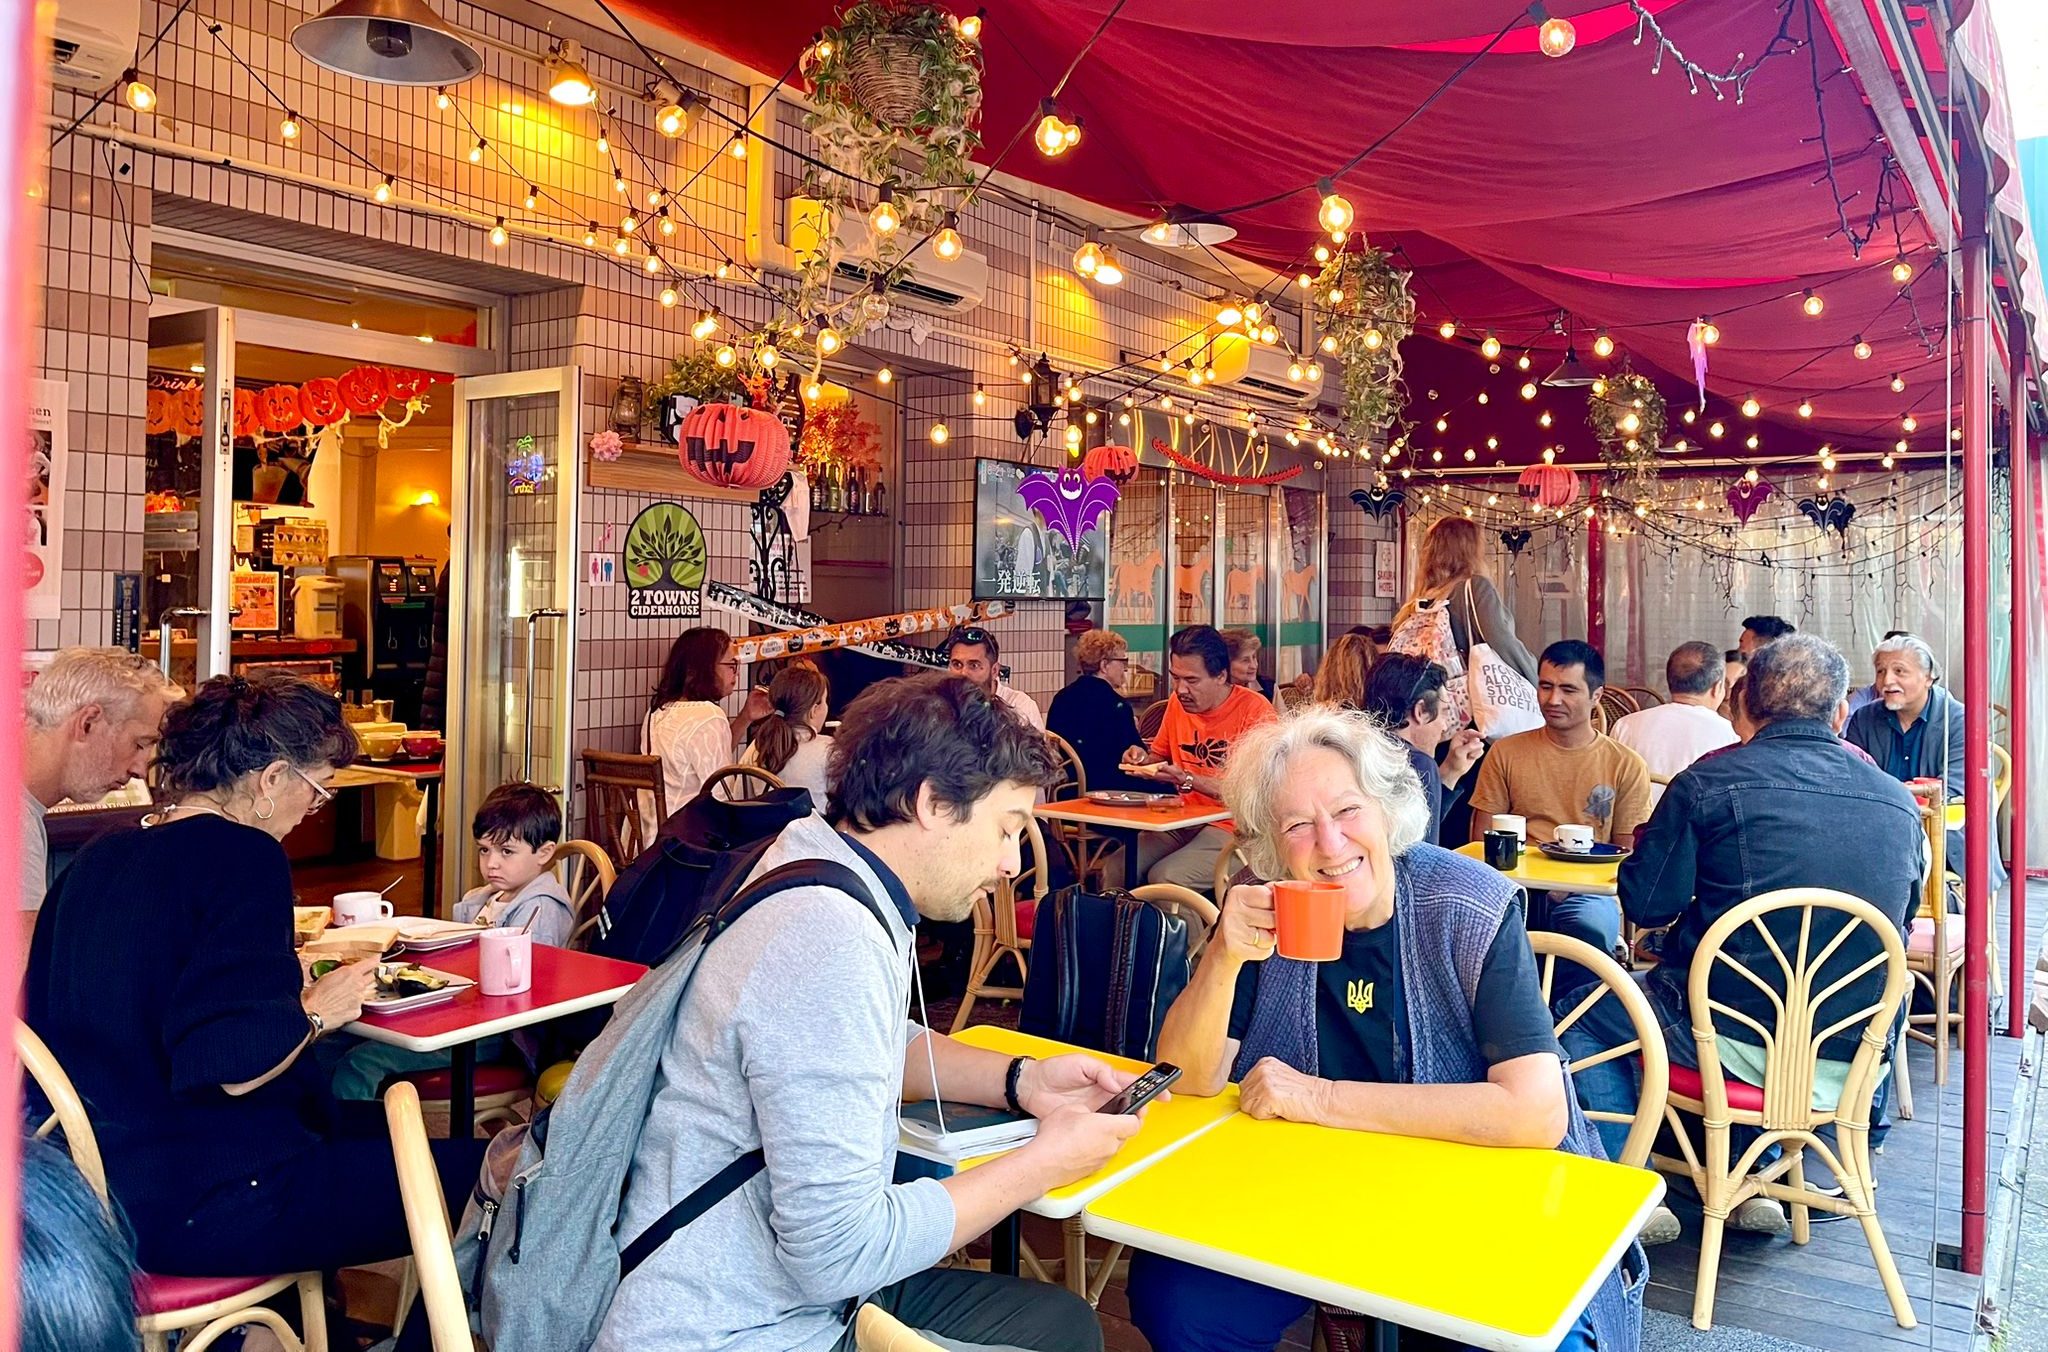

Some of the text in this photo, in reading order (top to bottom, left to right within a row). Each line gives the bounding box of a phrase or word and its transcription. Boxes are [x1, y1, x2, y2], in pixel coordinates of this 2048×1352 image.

[981, 569, 1041, 594] 一発逆転
[630, 589, 700, 605] 2 TOWNS
[630, 605, 700, 616] CIDERHOUSE
[1486, 685, 1534, 701] STRON
